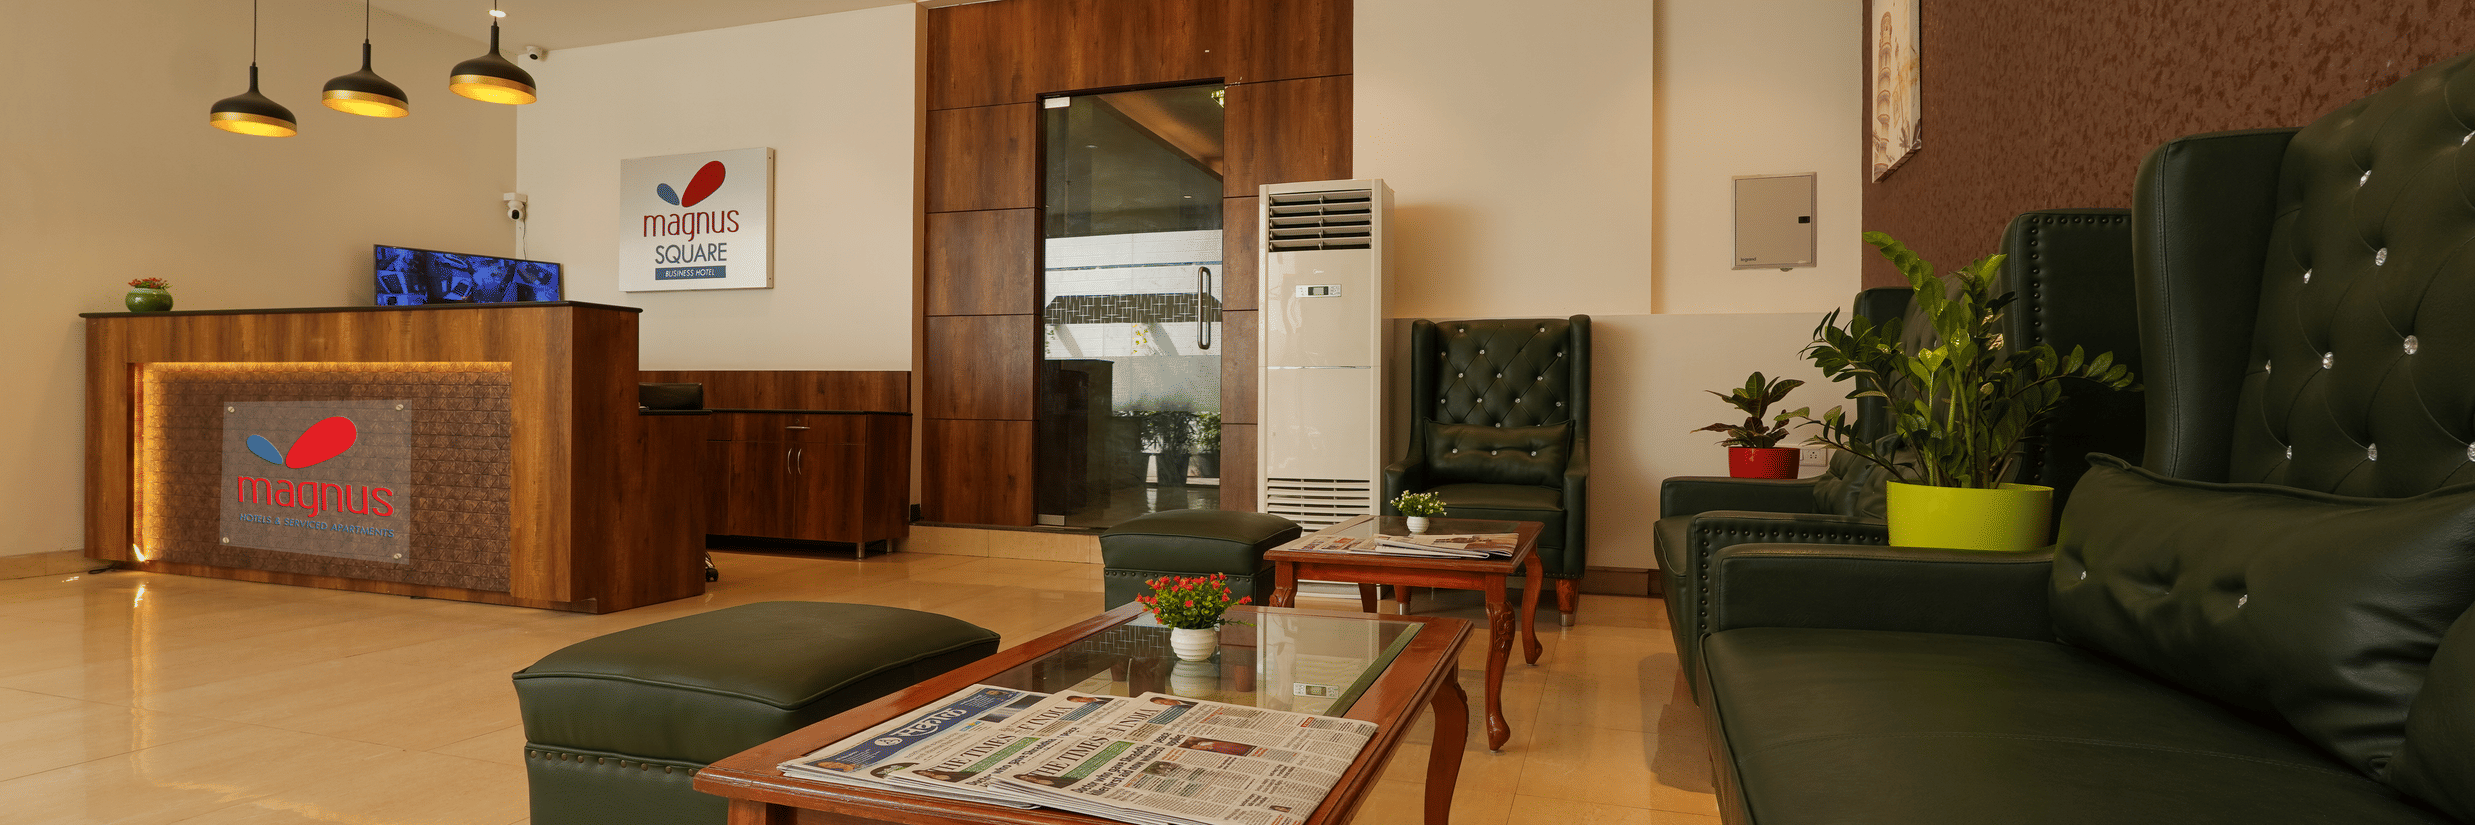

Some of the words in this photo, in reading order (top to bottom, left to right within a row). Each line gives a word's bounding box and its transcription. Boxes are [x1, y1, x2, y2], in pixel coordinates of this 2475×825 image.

[643, 209, 739, 242] magnus
[655, 242, 727, 265] SQUARE
[665, 268, 694, 278] BUSINESS
[695, 268, 715, 277] HOTEL
[237, 475, 394, 518] magnus
[239, 513, 272, 525] HOTELS
[274, 516, 281, 526] &
[284, 518, 328, 531] SERVICED
[330, 523, 395, 538] APARTMENTS
[962, 733, 1017, 758] TIMES
[1027, 706, 1073, 728] INDIA
[1057, 735, 1110, 762] TIMES
[1115, 708, 1159, 729] INDIA
